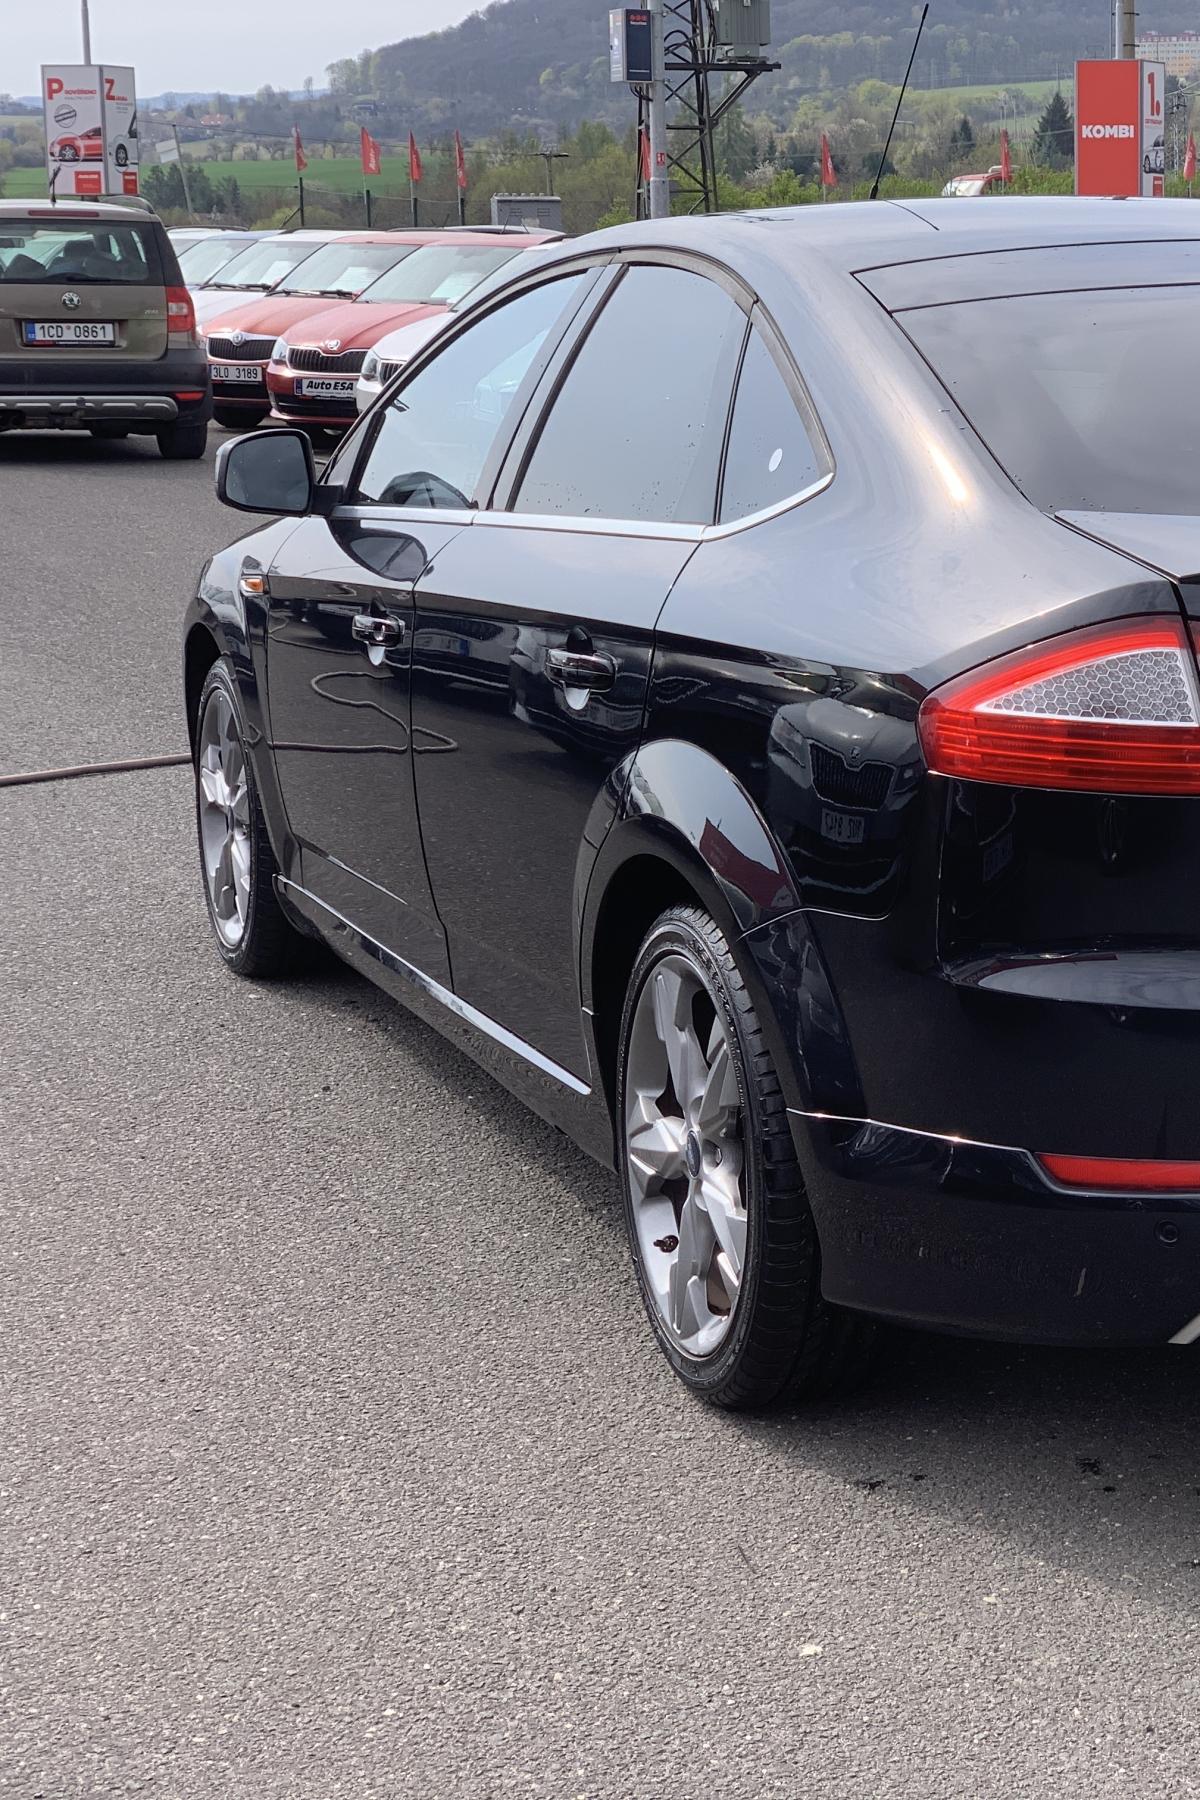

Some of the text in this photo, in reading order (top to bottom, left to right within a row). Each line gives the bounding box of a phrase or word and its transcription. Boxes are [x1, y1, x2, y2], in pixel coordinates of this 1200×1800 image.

[1148, 72, 1161, 116] 1.
[1082, 125, 1134, 138] KOMBI
[40, 325, 63, 338] 1CD
[74, 325, 106, 338] 0861
[236, 368, 258, 379] 3189
[307, 380, 354, 391] Auto ESA
